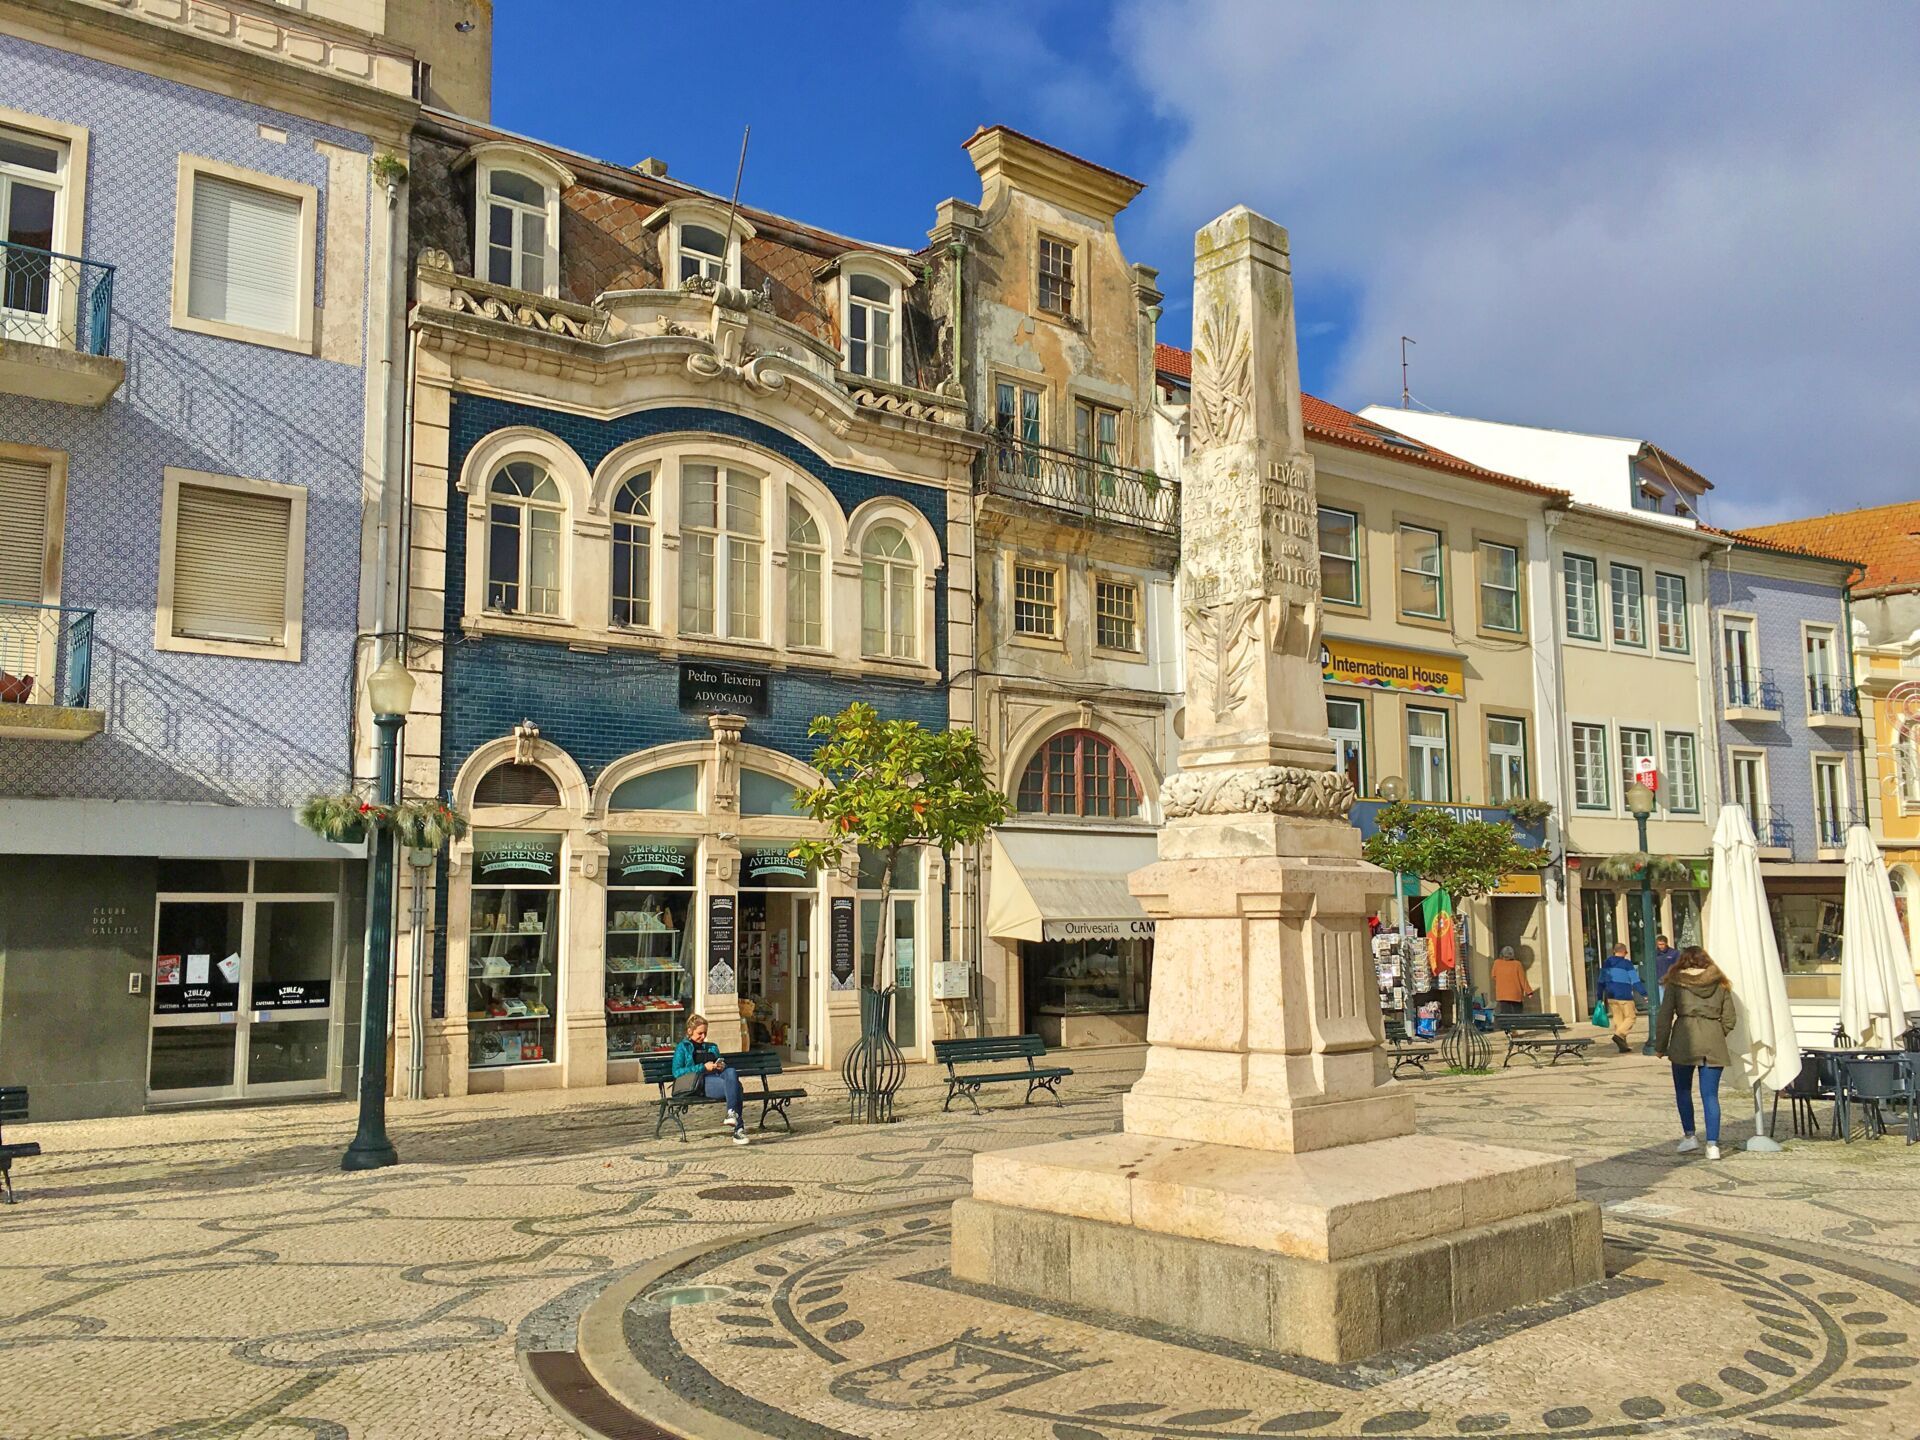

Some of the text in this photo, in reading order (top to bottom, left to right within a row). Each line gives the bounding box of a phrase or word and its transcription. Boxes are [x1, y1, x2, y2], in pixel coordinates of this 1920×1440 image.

[1333, 655, 1449, 685] International House
[688, 669, 761, 687] Pedro Teixeira
[694, 691, 753, 704] ADVOGADO
[480, 850, 554, 862] AVEIRENSE
[620, 853, 686, 865] AVEIRENSE
[1065, 922, 1119, 934] Ourivesaria
[183, 989, 211, 999] AZULEJO
[278, 986, 304, 996] AZULEJO
